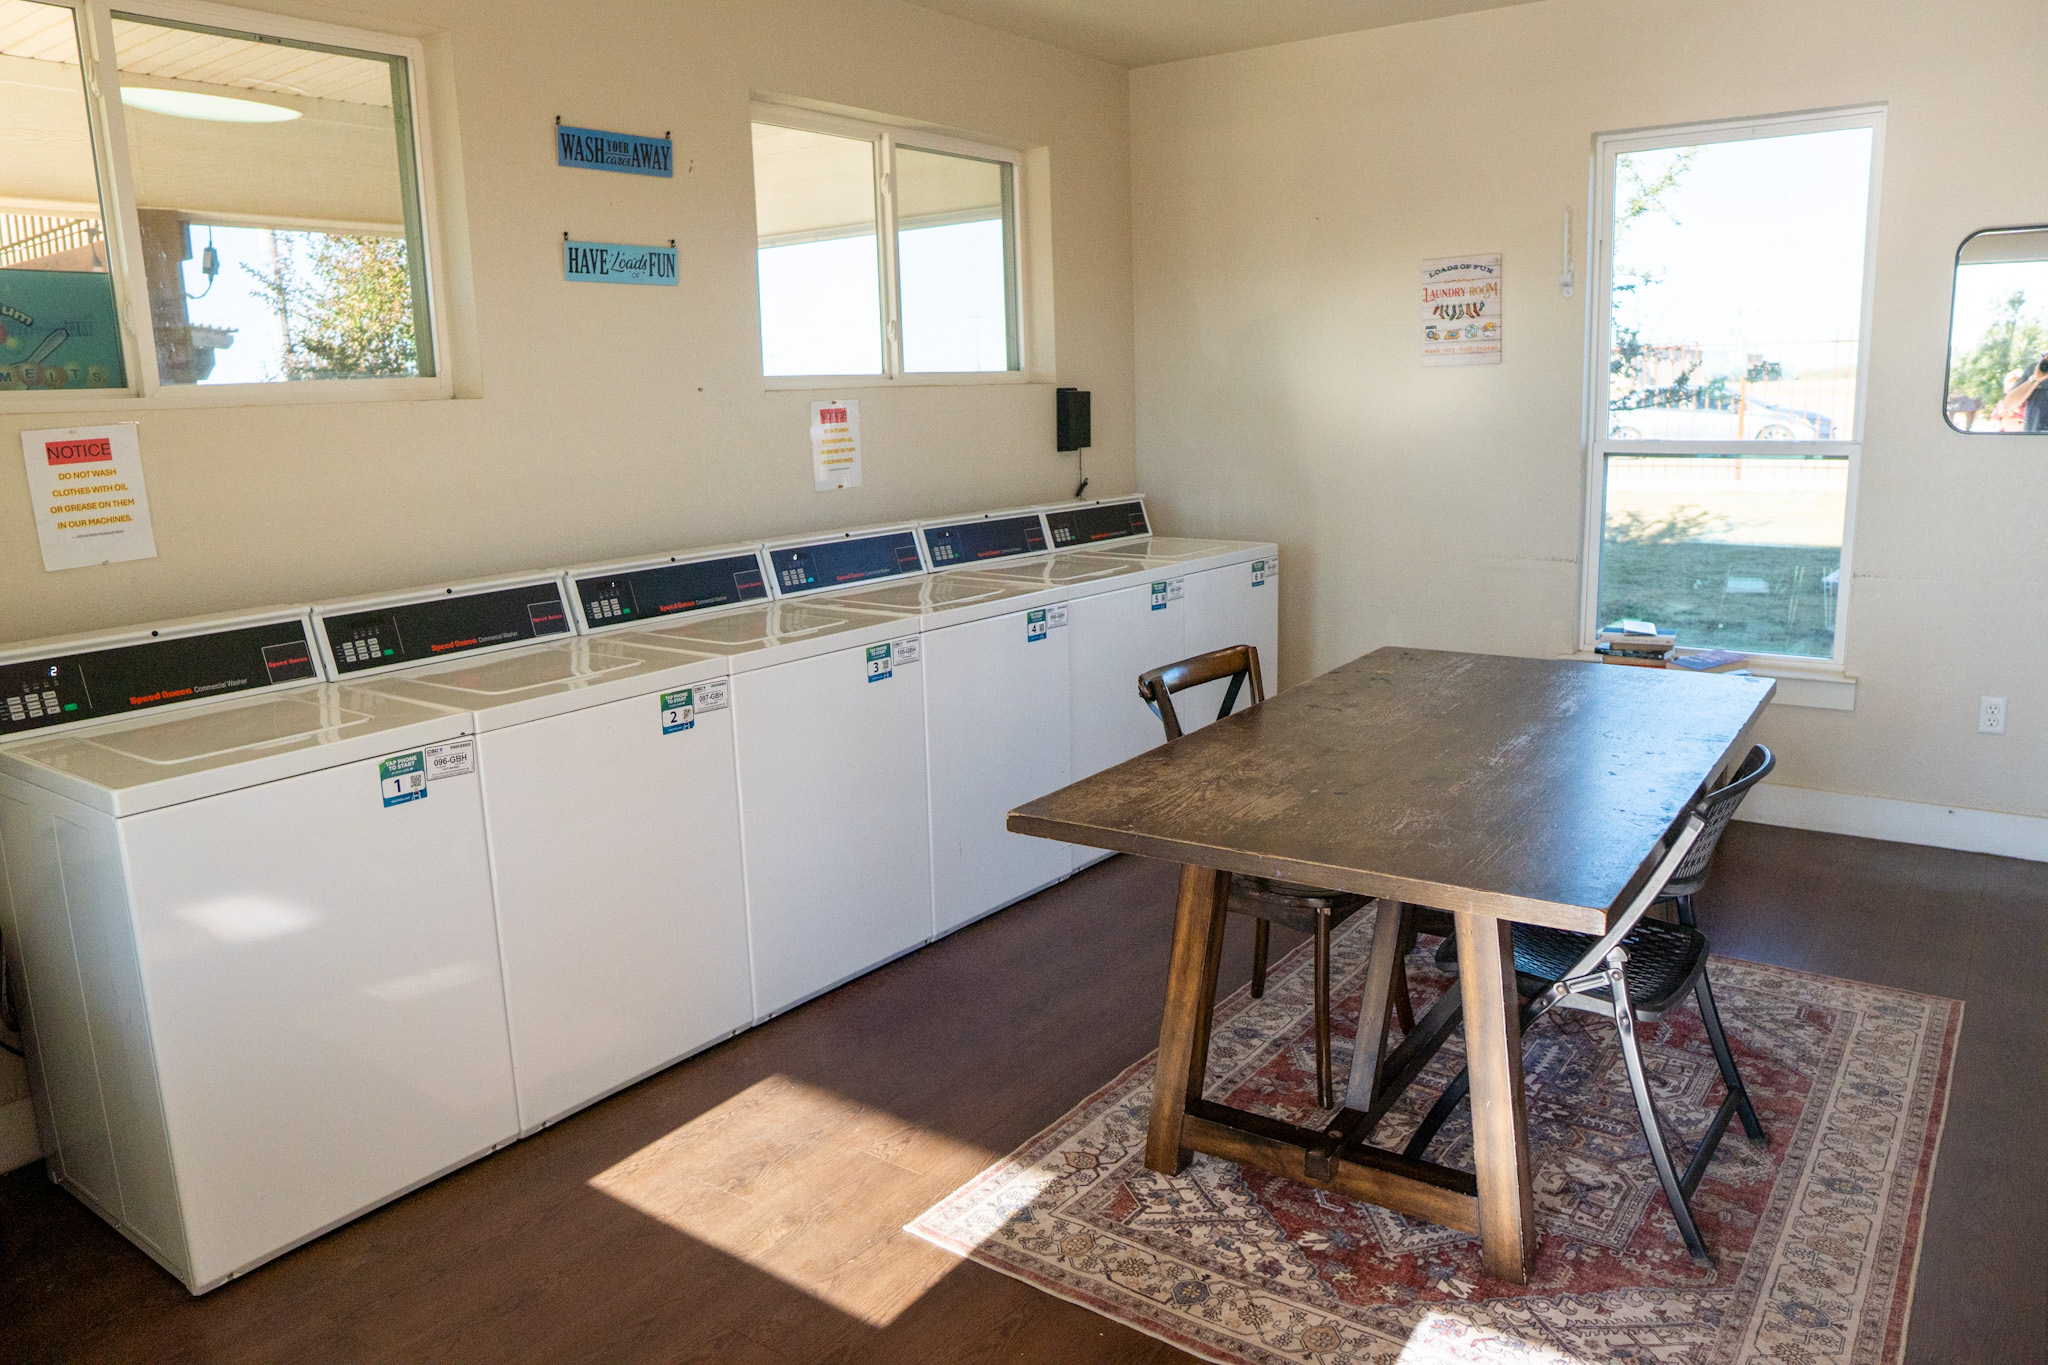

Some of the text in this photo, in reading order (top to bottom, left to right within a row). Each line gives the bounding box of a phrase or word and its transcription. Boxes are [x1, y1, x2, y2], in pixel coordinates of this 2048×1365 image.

[560, 133, 670, 170] WASH YOUR cares AWAY
[568, 247, 609, 274] HAVE
[611, 251, 647, 273] Loads
[648, 252, 675, 277] FUN
[1429, 265, 1459, 278] LOADS
[1473, 265, 1493, 274] FUN
[1423, 282, 1497, 303] LAUNDRY ROOM
[47, 442, 111, 460] NOTICE
[58, 468, 117, 480] DO NOT WASH
[52, 484, 128, 497] CLOTHES WITH OIL
[64, 503, 97, 512] GREASE
[113, 499, 135, 507] THEM
[68, 520, 87, 528] OUR
[88, 515, 133, 526] MACHINES.
[1032, 625, 1036, 633] 4
[431, 642, 454, 652] Speed
[454, 638, 478, 648] Queen
[268, 660, 288, 668] Speed
[874, 662, 879, 672] 3
[130, 678, 248, 705] Speed Queen Commercial Washer
[670, 711, 677, 723] 2
[397, 755, 417, 764] PHONE
[398, 761, 415, 769] START
[434, 754, 467, 766] 096-GBH
[394, 779, 401, 792] 1
